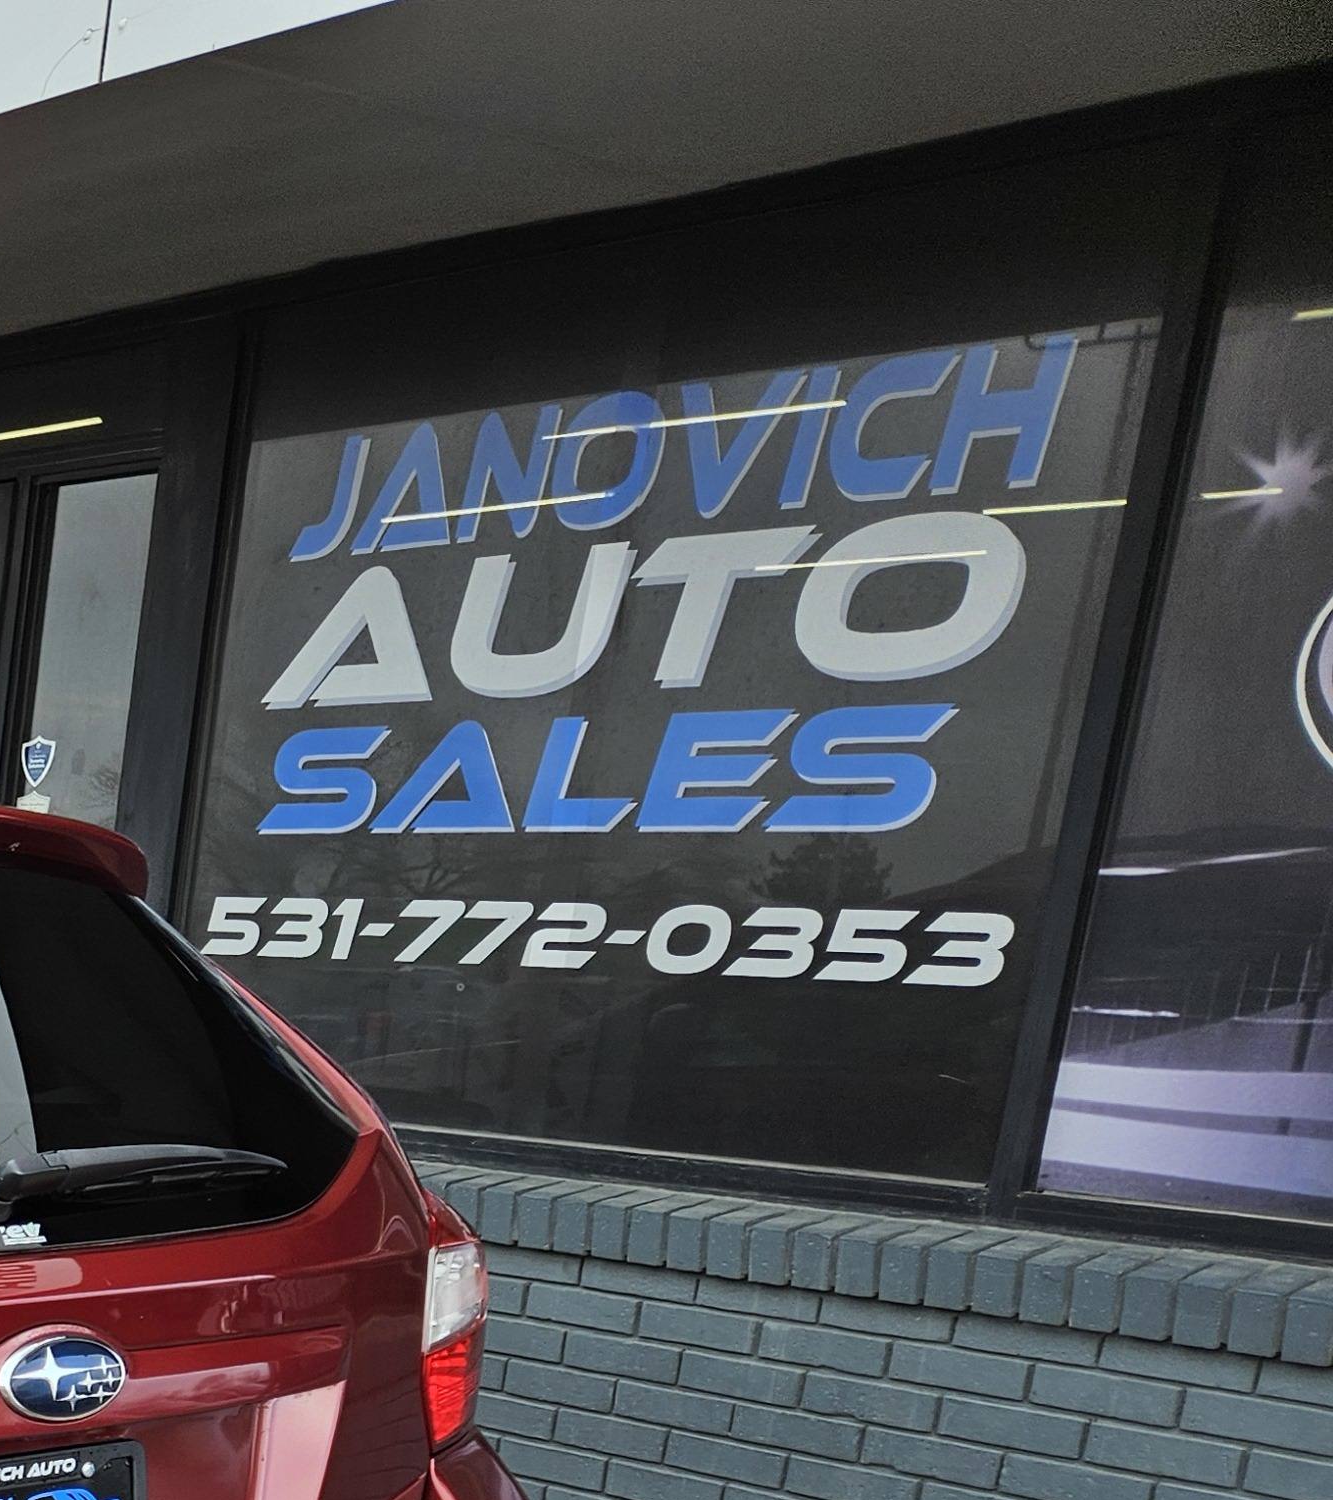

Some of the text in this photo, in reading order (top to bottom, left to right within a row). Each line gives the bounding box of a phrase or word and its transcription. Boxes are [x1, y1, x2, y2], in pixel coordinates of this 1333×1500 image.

[288, 336, 1079, 562] JANOVICH
[261, 511, 1026, 709] AUTO
[257, 703, 960, 835] SALES
[200, 896, 1017, 988] 531-772-0353
[27, 1458, 76, 1478] AUTO
